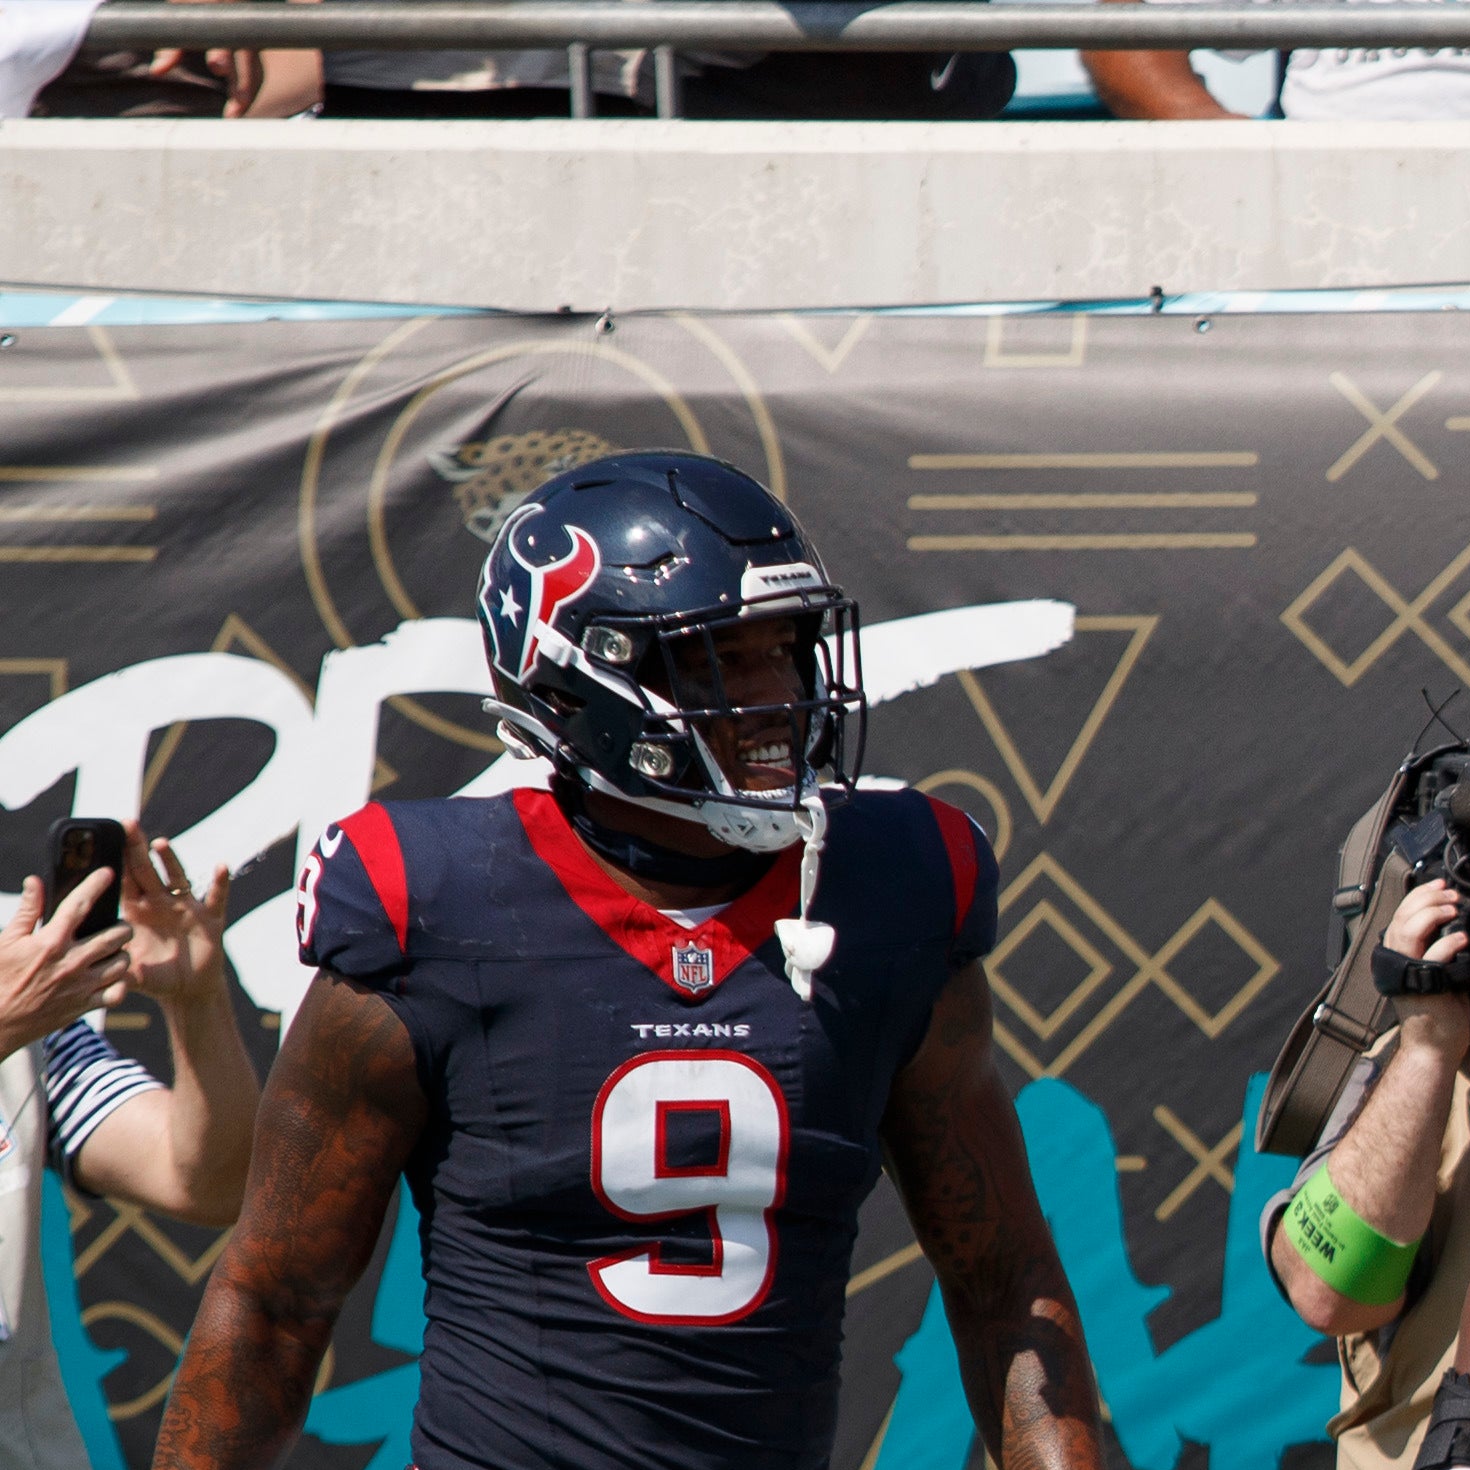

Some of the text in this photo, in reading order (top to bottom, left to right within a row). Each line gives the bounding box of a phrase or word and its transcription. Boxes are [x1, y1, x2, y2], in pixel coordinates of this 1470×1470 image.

[759, 570, 813, 586] TEXANS
[680, 964, 708, 983] NFL
[630, 1023, 751, 1039] TEXANS
[586, 1049, 791, 1327] 9
[1298, 1215, 1336, 1264] WEEK
